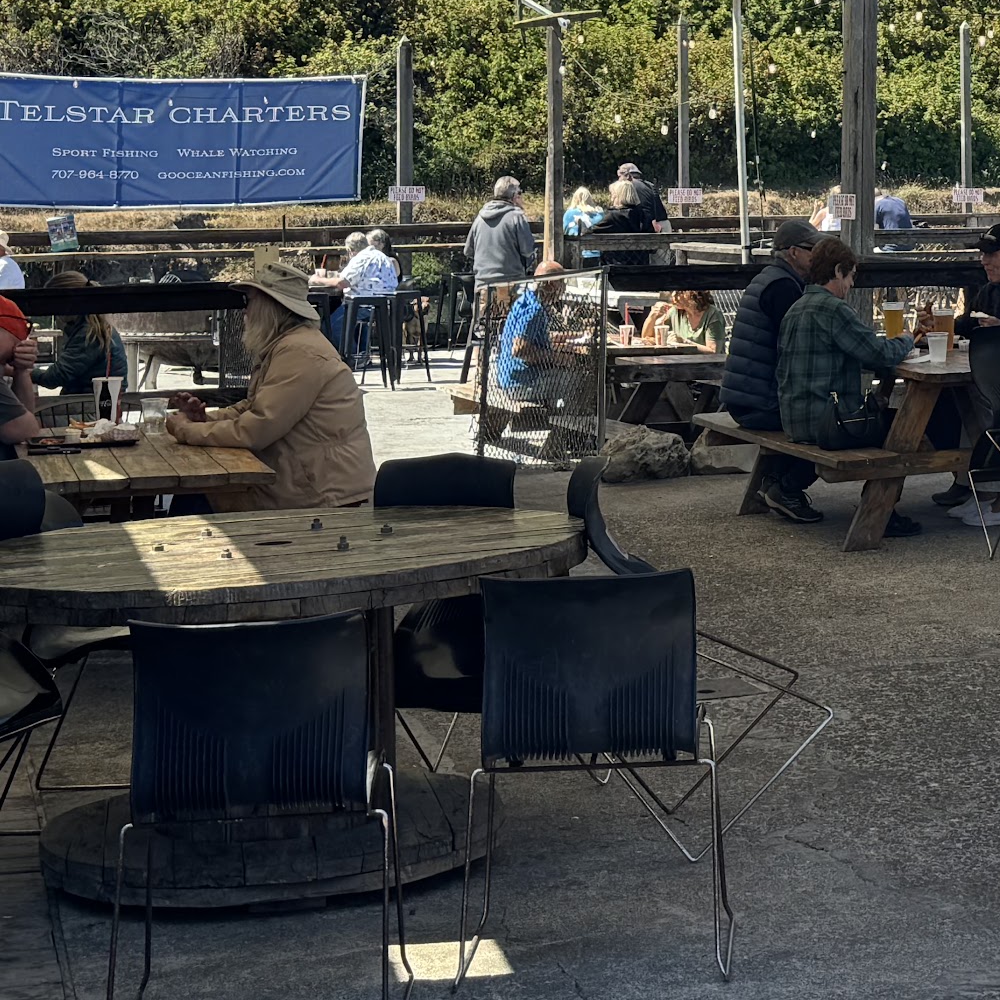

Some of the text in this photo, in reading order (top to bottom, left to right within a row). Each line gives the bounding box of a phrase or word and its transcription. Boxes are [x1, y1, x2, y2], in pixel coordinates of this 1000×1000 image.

[0, 100, 351, 124] TELSTAR CHARTERS
[52, 169, 139, 180] 707-964-8770
